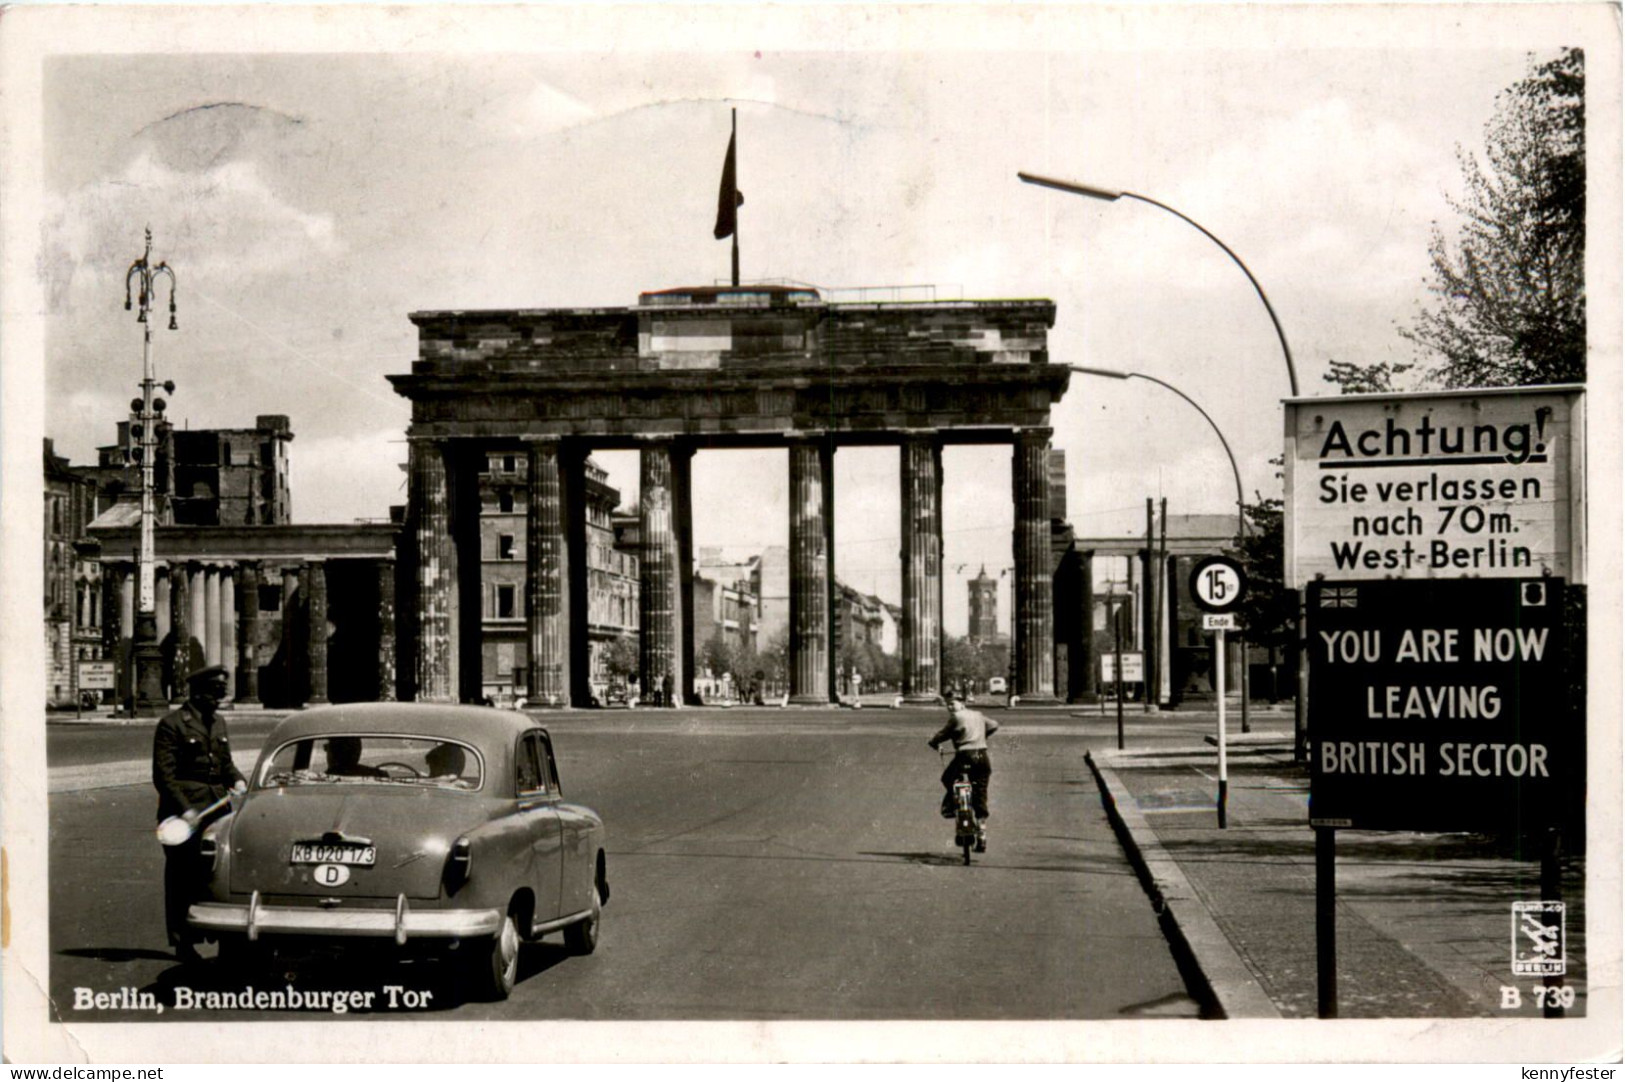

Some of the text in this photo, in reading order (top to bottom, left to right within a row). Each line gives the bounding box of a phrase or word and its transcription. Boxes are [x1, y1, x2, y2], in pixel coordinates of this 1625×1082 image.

[1319, 407, 1551, 464] Achtung!
[1319, 473, 1541, 503] Sie verlassen
[1353, 507, 1423, 536] nach
[1330, 538, 1532, 570] West-Berlin
[1205, 569, 1226, 600] 15
[1208, 617, 1229, 627] Ende
[1319, 628, 1549, 663] YOU ARE NOW
[1367, 685, 1501, 719] LEAVING
[1321, 742, 1550, 777] BRITISH SECTOR
[325, 866, 339, 883] D
